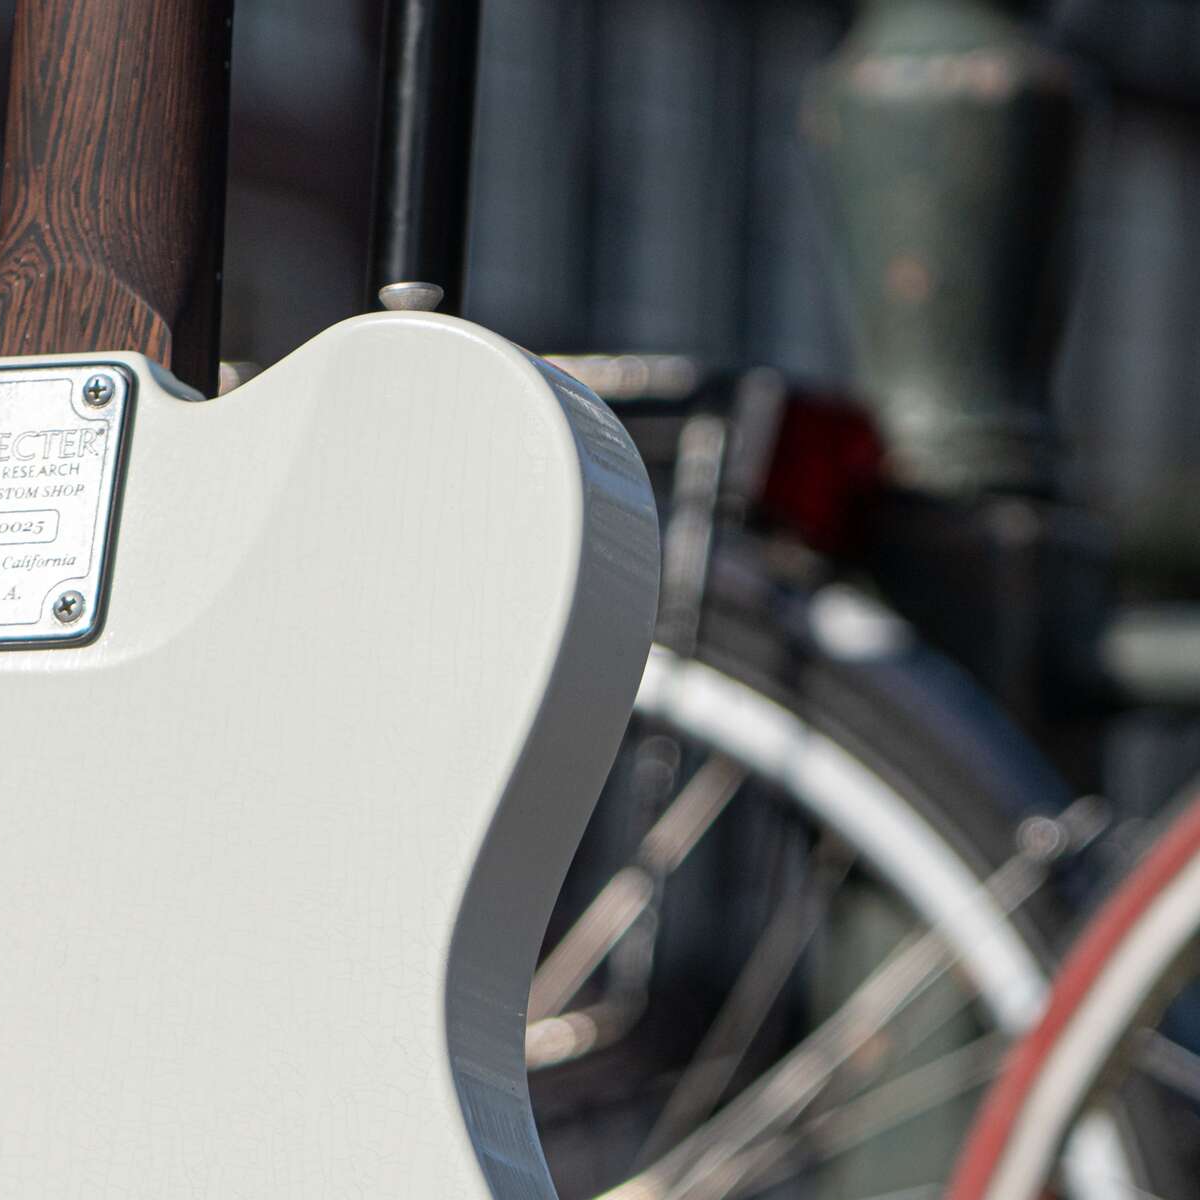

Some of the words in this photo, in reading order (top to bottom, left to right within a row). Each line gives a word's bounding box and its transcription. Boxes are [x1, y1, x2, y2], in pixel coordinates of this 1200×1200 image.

[2, 463, 80, 480] RESEARCH
[43, 484, 85, 499] SHOP
[2, 553, 77, 571] California
